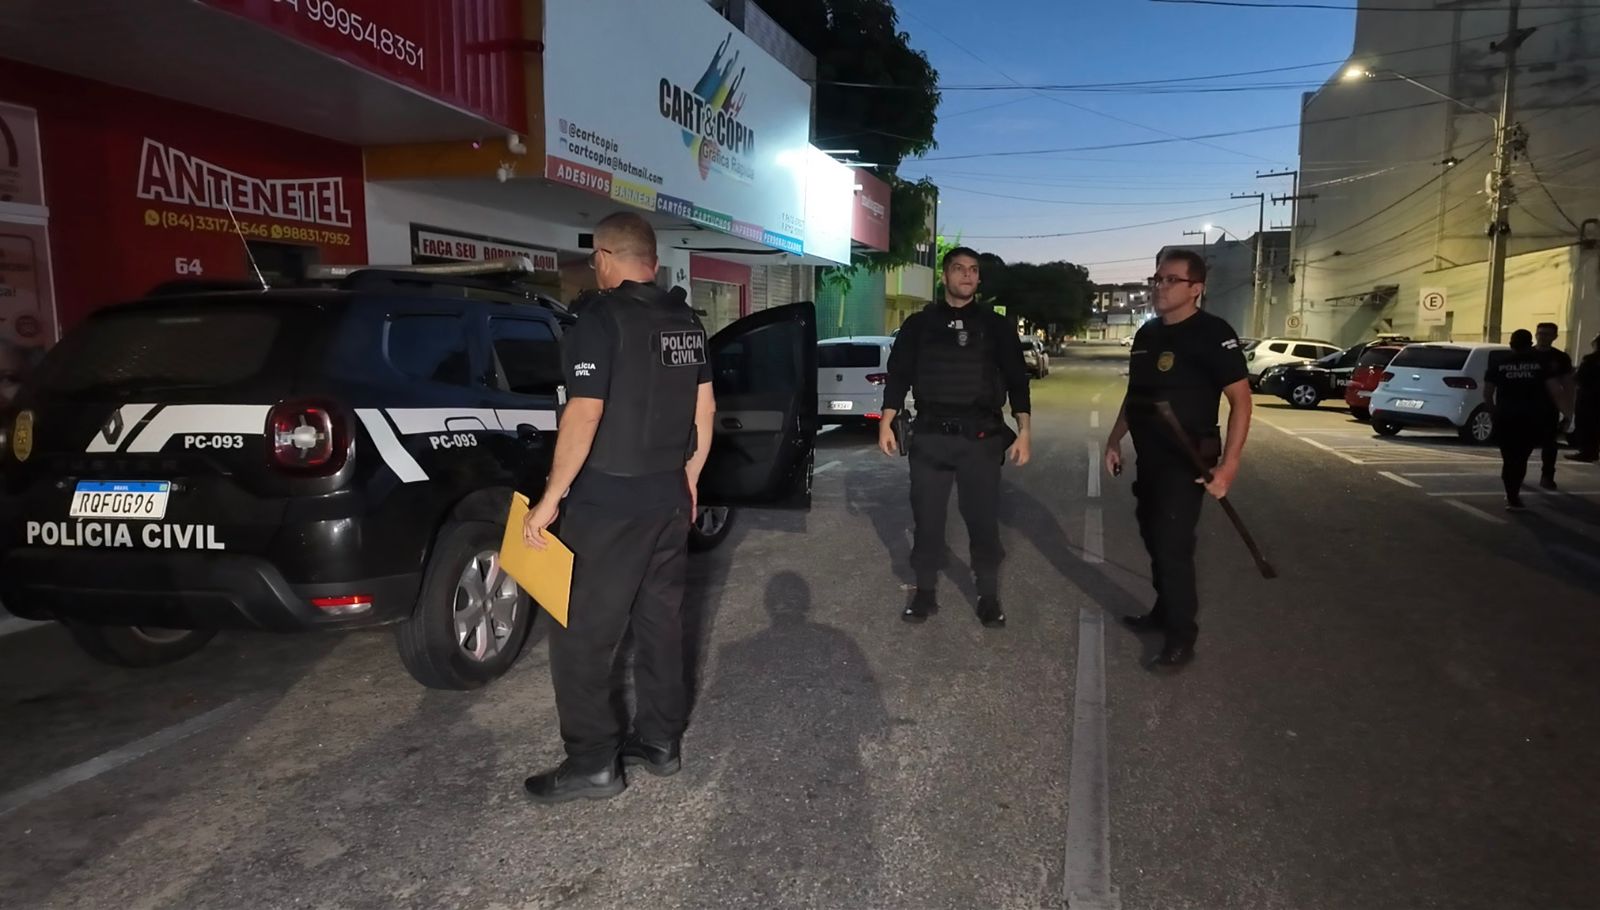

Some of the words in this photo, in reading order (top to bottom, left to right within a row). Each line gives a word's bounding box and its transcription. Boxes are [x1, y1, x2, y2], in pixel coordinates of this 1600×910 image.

[568, 122, 619, 153] @cartcopia
[568, 141, 664, 185] cartcopia@hotmail.com
[136, 136, 352, 228] ANTENETEL
[557, 164, 610, 193] ADESIVOS
[284, 226, 351, 246] 98831.7952
[422, 238, 452, 258] FAÇA
[456, 242, 477, 260] SEU
[533, 254, 556, 270] AQUI
[175, 257, 203, 276] 64
[662, 332, 703, 351] POLÍCIA
[671, 350, 697, 364] CIVIL
[184, 434, 244, 449] PC-093
[429, 433, 478, 450] PC-093
[26, 518, 134, 547] POLÍCIA
[142, 524, 226, 550] CIVIL
